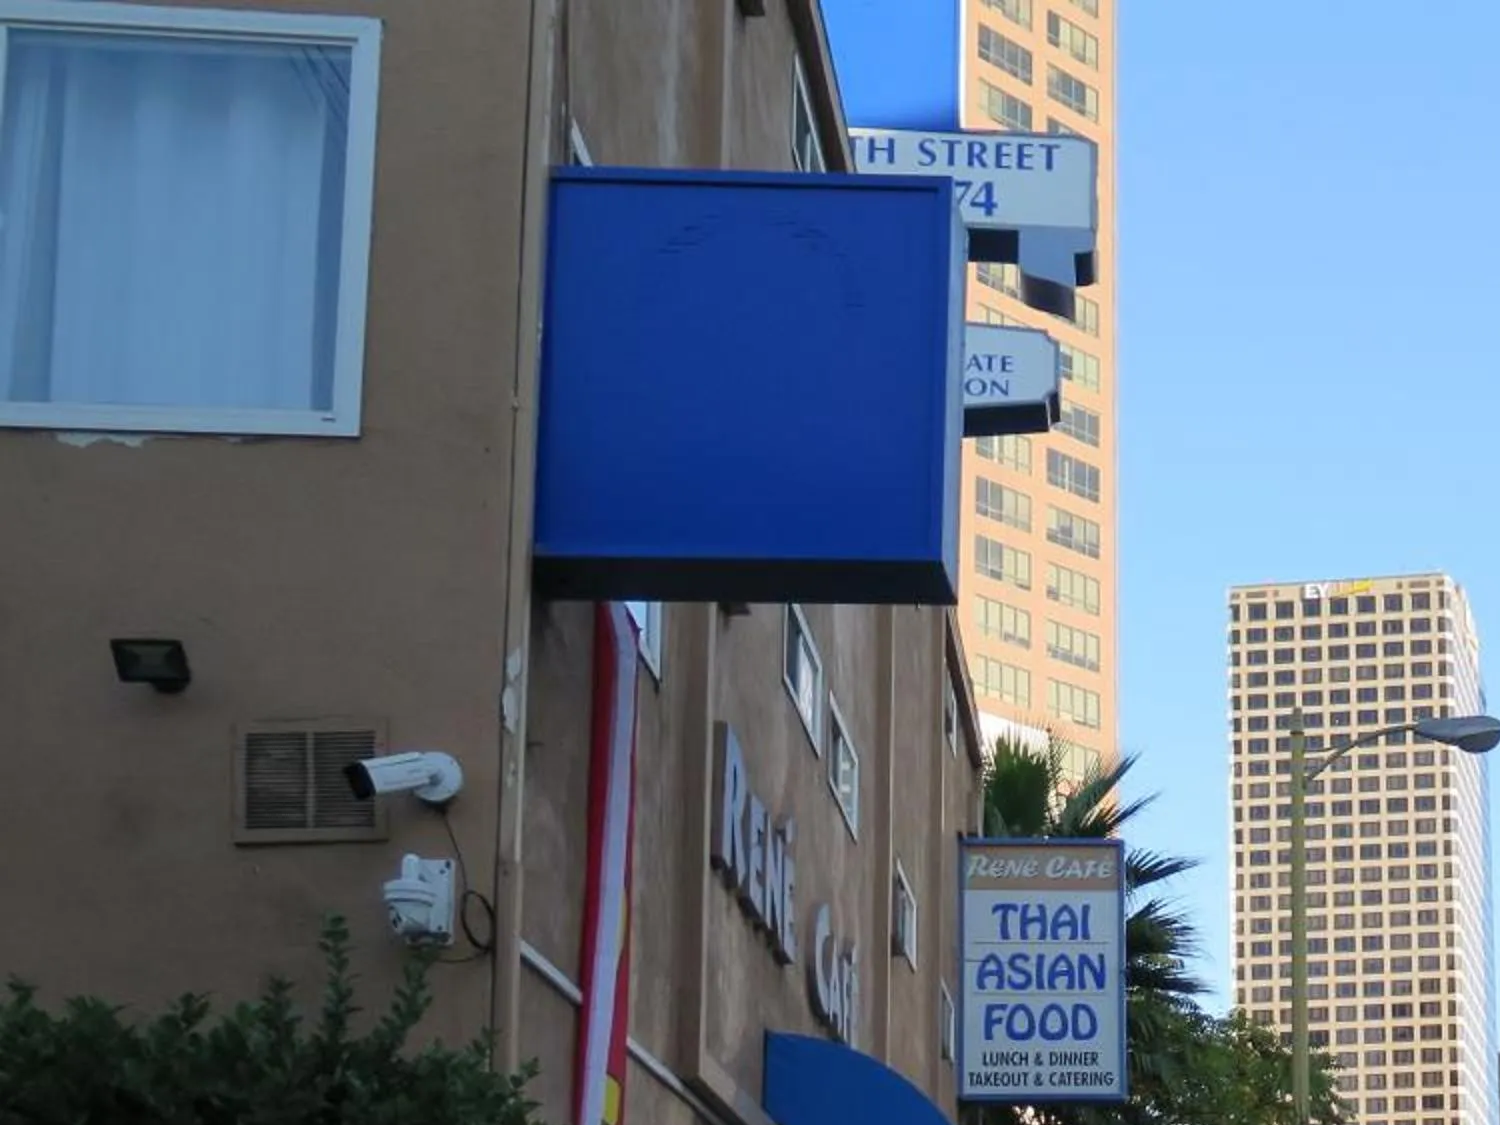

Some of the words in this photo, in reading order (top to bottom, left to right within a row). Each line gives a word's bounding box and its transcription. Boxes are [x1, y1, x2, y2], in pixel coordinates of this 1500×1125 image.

[918, 138, 1061, 172] STREET
[991, 903, 1091, 941] THAI
[975, 953, 1107, 991] ASIAN
[983, 1003, 1098, 1042] FOOD
[981, 1051, 1029, 1067] LUNCH
[1033, 1051, 1044, 1067] &
[1049, 1051, 1100, 1068] DINNER
[968, 1071, 1028, 1088] TAKEOUT
[1033, 1072, 1044, 1087] &
[1049, 1072, 1115, 1088] CATERING
